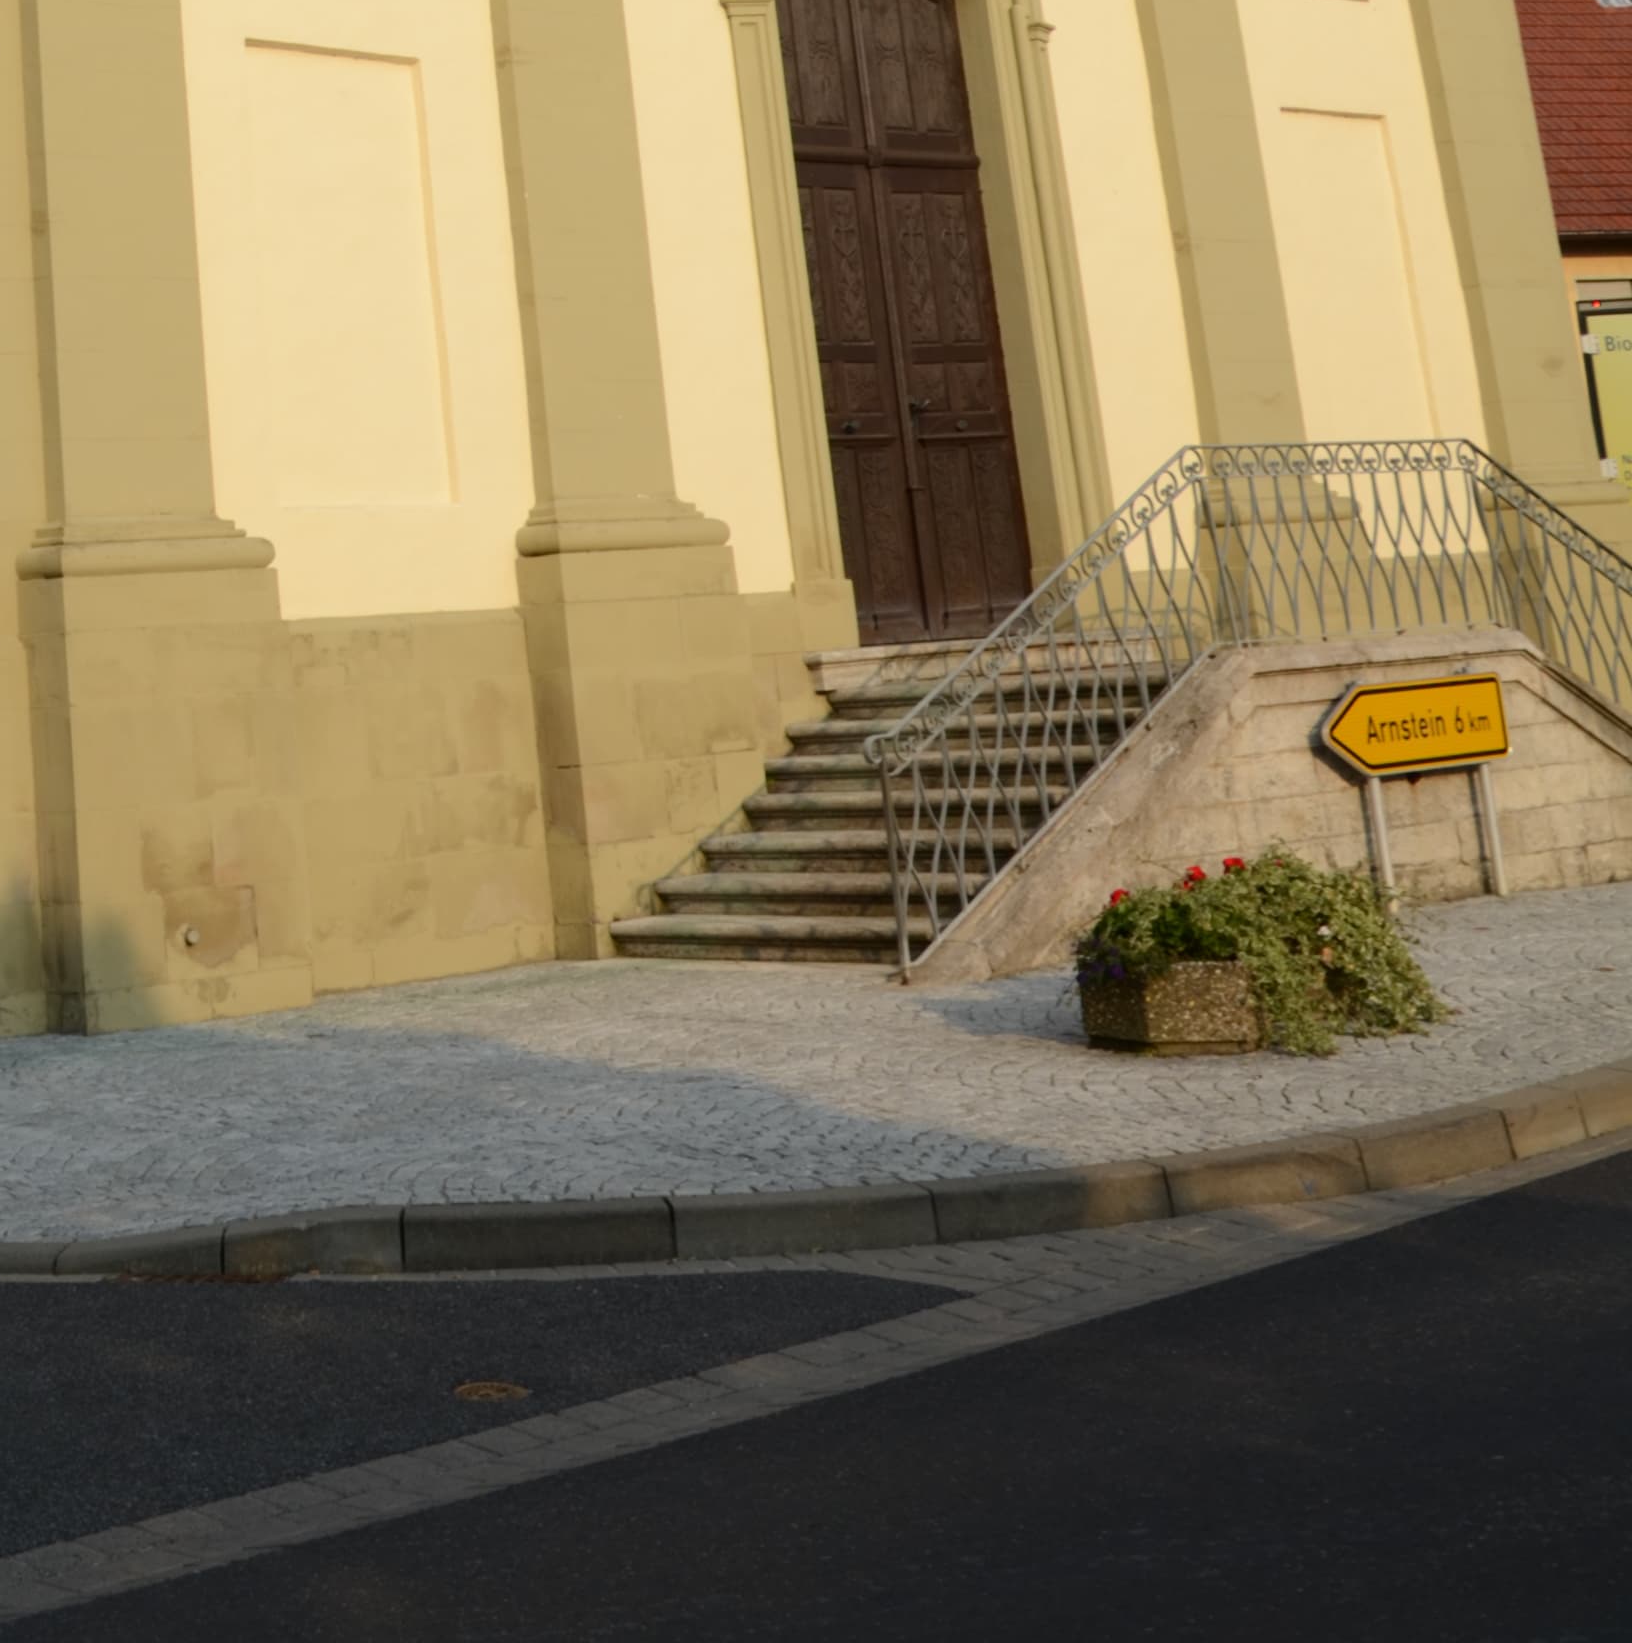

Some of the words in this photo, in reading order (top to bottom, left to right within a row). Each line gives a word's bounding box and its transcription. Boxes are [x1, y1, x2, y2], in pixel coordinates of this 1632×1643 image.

[1367, 708, 1447, 744] Arnstein
[1454, 705, 1465, 734] 6
[1467, 711, 1491, 732] km
